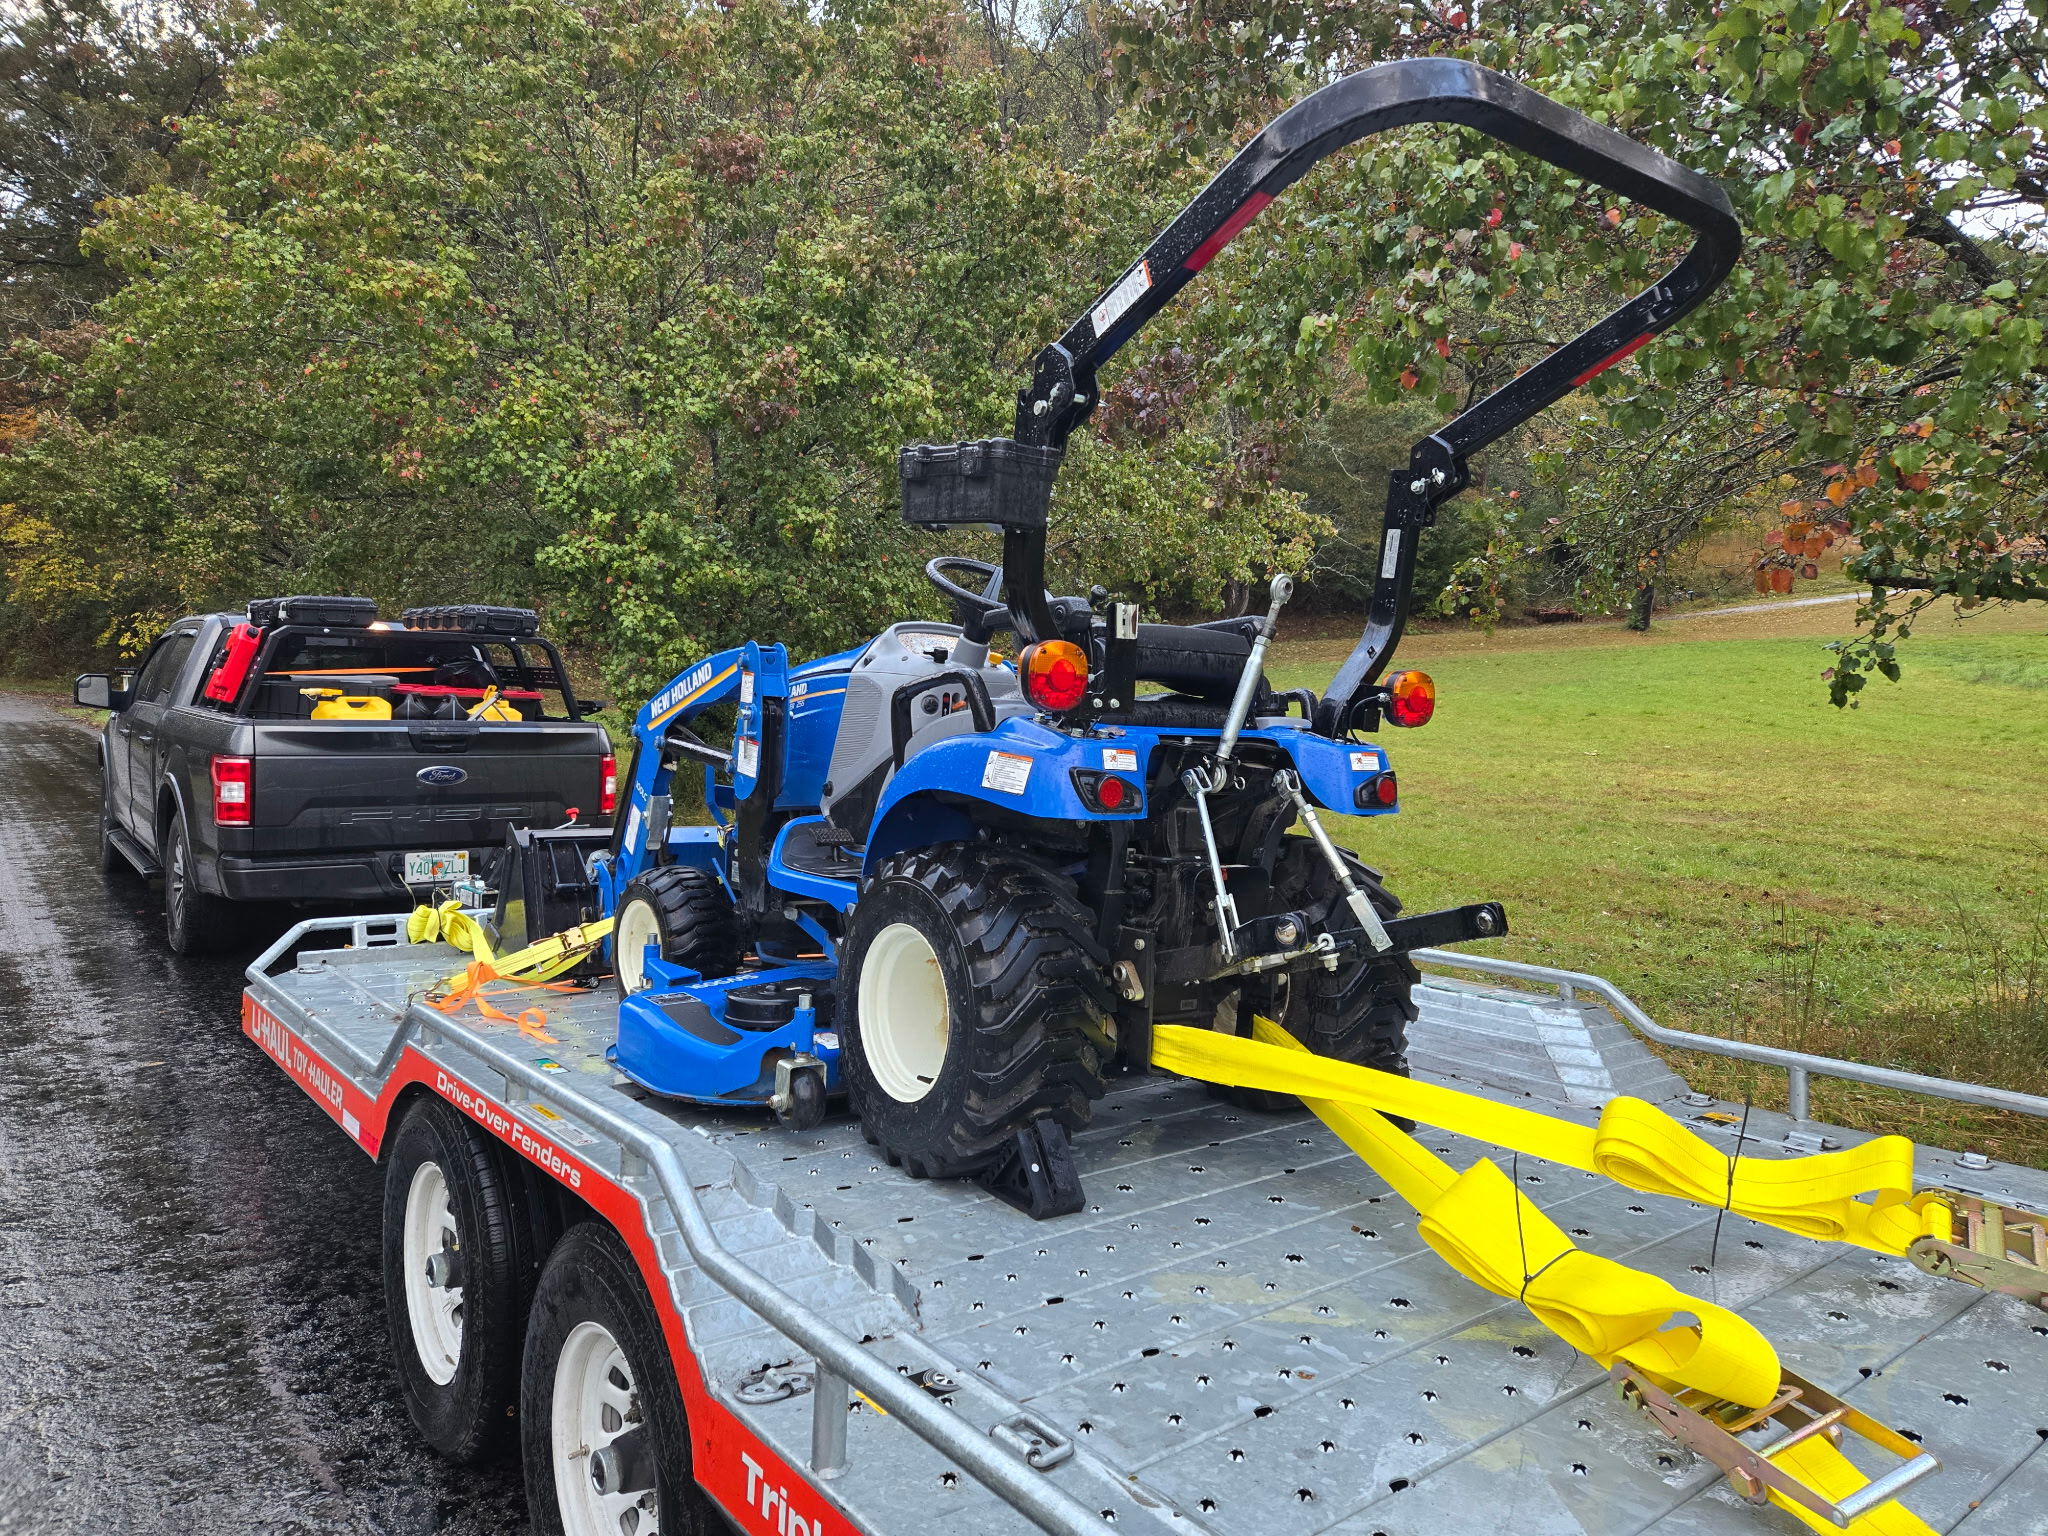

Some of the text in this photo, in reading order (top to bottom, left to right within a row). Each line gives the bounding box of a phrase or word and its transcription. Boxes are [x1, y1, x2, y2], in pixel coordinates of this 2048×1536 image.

[651, 691, 671, 719] NEW
[671, 662, 712, 704] HOLLAND
[444, 860, 465, 874] ZLJ
[251, 1004, 292, 1070] U-HAUL
[293, 1046, 309, 1078] TOY
[436, 1071, 510, 1135] Drive-Over
[511, 1121, 581, 1188] Fenders
